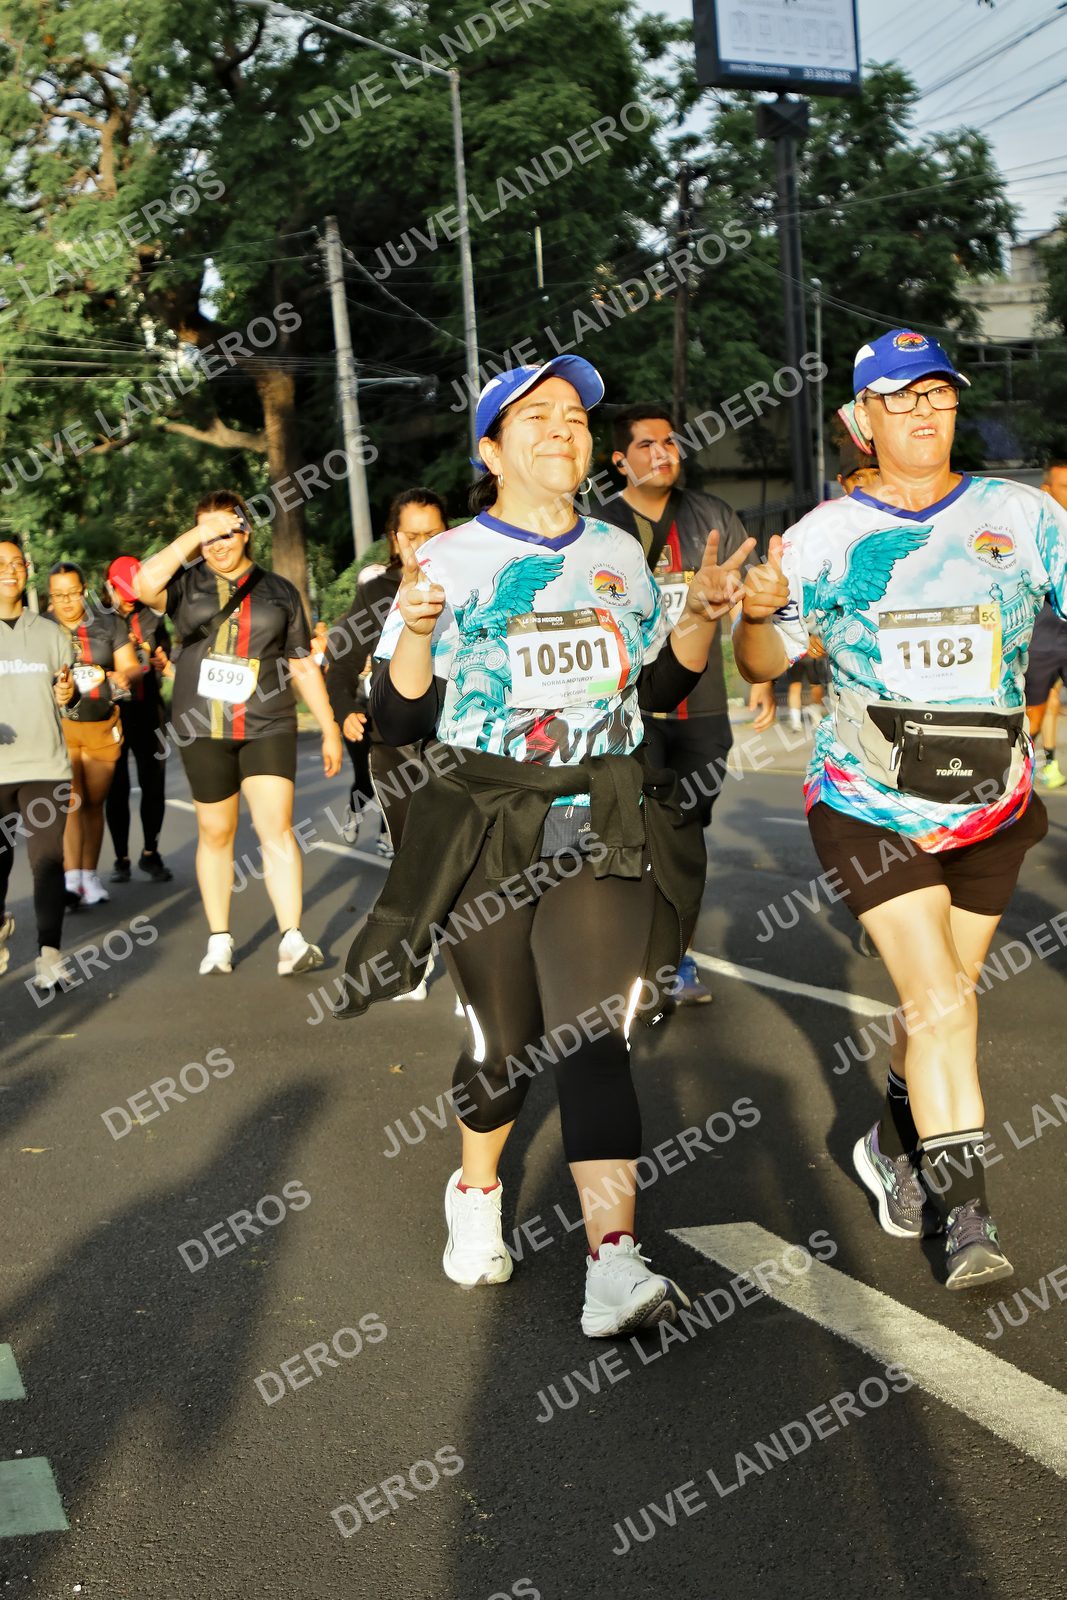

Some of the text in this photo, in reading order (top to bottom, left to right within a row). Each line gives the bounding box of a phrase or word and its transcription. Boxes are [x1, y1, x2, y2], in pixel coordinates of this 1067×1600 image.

[981, 611, 996, 622] 5K
[516, 637, 610, 678] 10501
[896, 637, 974, 670] 1183
[207, 667, 244, 685] 6599
[935, 769, 974, 777] TOPTIME
